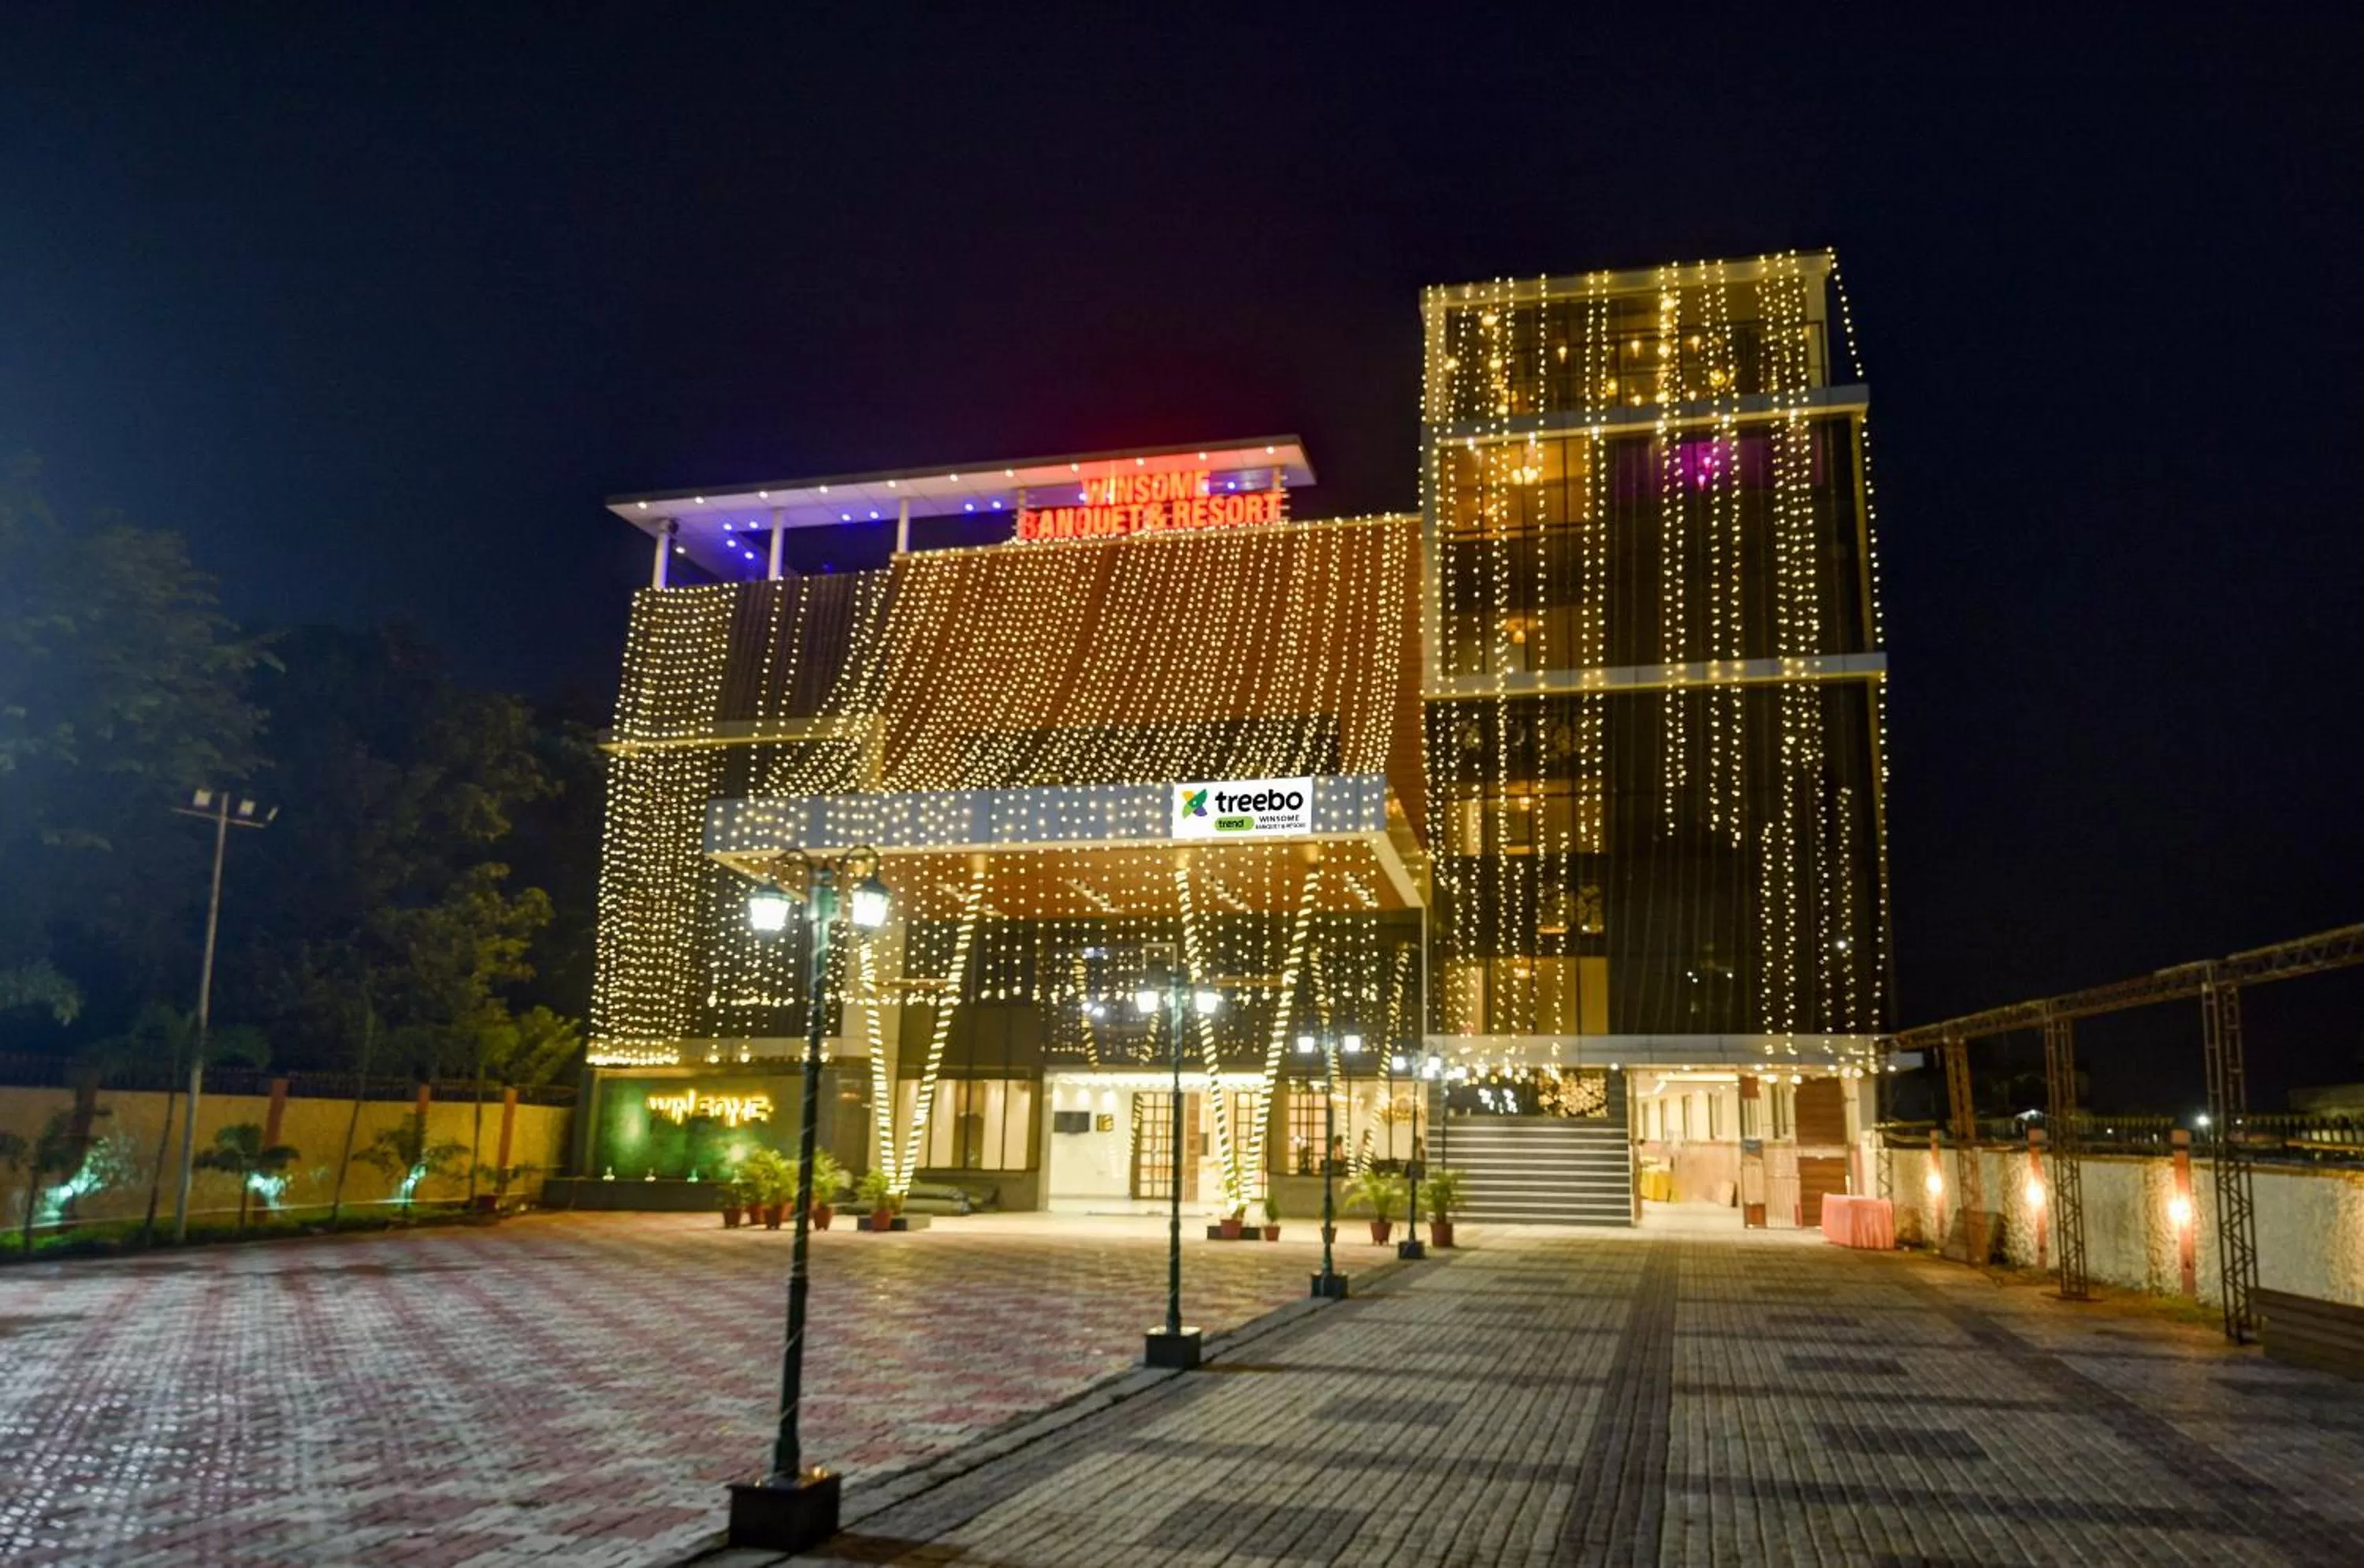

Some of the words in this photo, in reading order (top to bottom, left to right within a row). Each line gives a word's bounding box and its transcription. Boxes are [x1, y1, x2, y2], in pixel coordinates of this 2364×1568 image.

[1082, 470, 1210, 505] WINSOME
[1018, 503, 1142, 540] BANQUET
[1144, 502, 1168, 530] &
[1171, 491, 1281, 528] RESORT
[1214, 789, 1303, 813] treebo
[1218, 819, 1244, 828] trend
